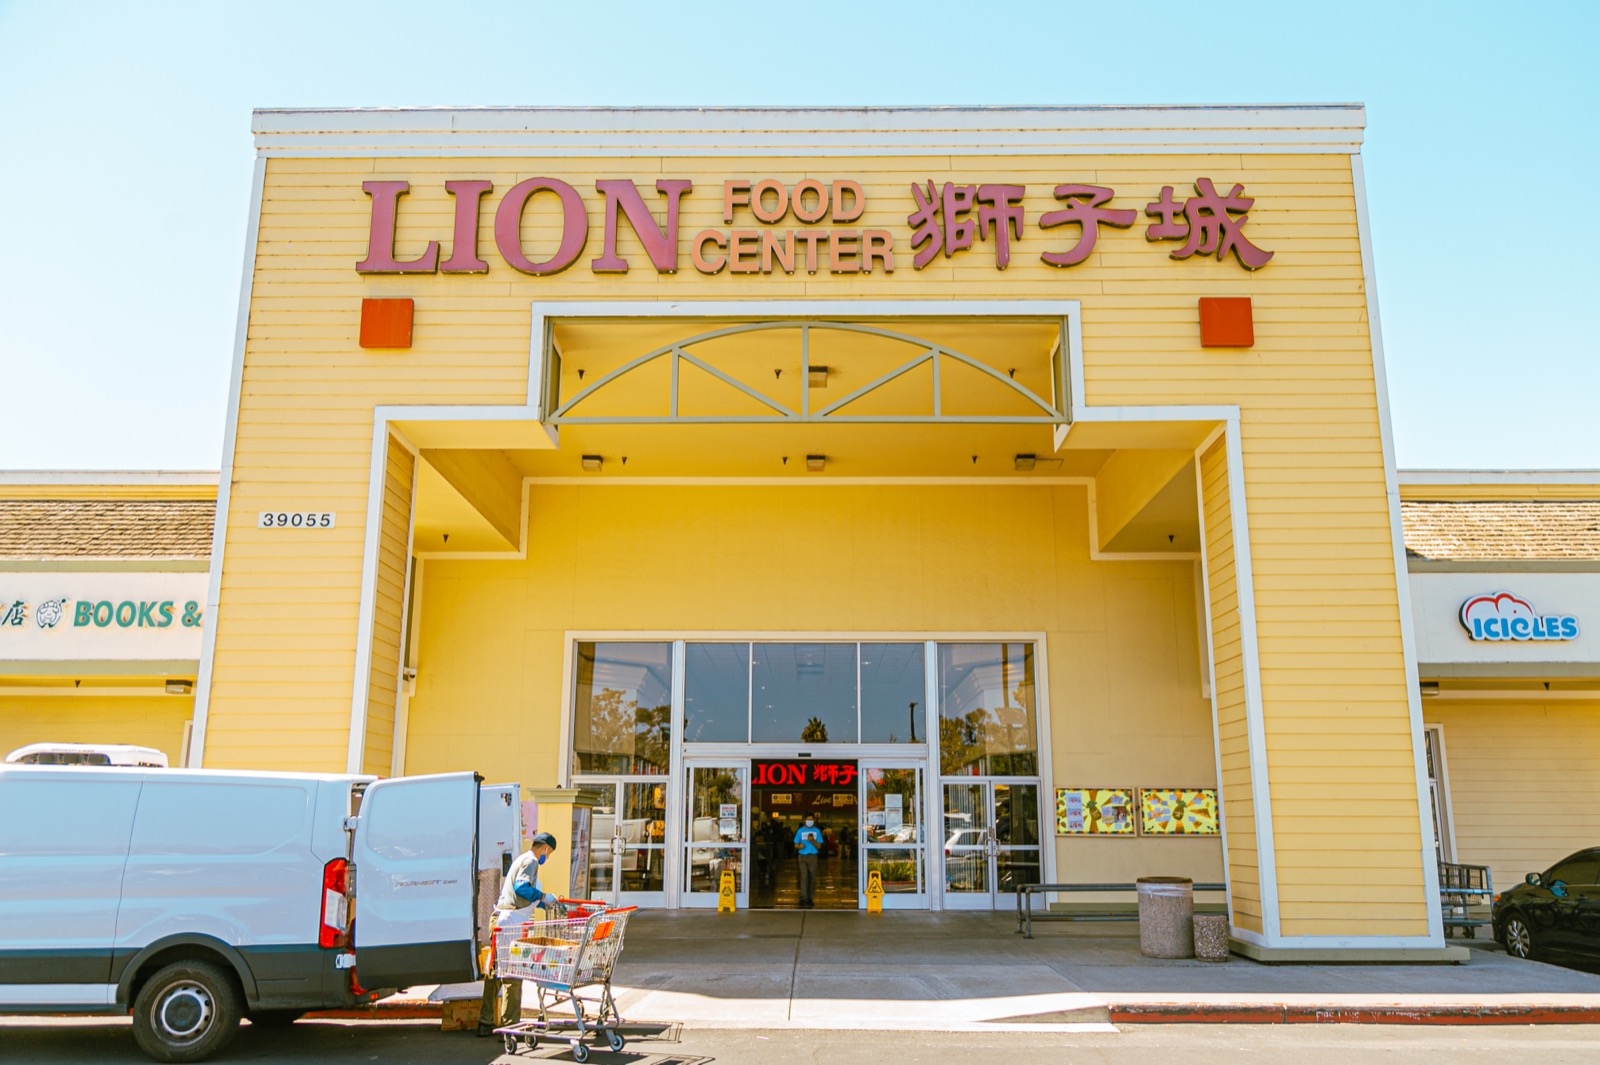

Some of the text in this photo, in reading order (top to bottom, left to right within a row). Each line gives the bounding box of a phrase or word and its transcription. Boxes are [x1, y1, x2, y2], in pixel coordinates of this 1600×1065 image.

[723, 179, 865, 225] FOOD
[907, 177, 1275, 271] 獅子城
[356, 177, 692, 275] LION
[691, 229, 895, 275] CENTER
[263, 512, 331, 527] 39055
[74, 600, 204, 628] BOOKS &
[1473, 617, 1578, 638] ICICLES
